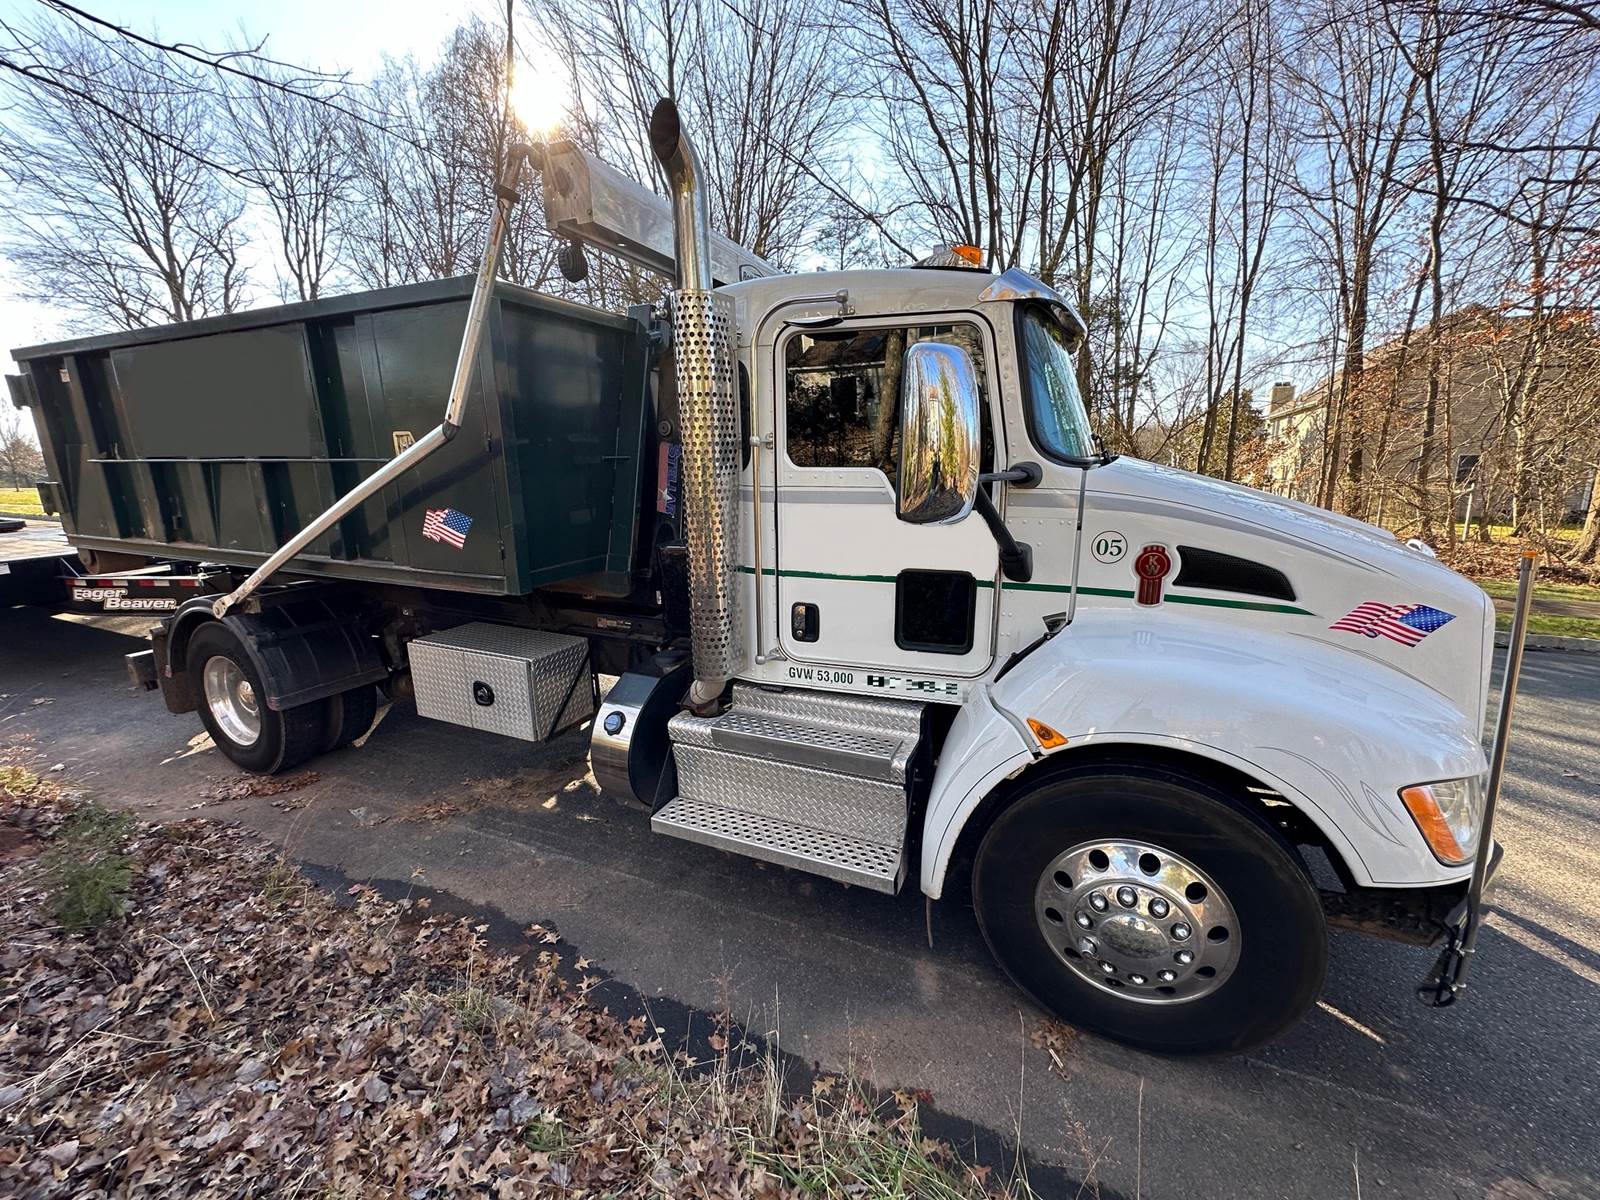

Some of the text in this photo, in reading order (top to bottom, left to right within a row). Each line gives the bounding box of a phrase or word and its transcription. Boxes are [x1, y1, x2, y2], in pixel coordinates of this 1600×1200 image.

[1096, 538, 1122, 556] 05
[73, 588, 127, 601] Eager
[104, 597, 175, 610] Beaver
[788, 666, 853, 684] GVW 53,000
